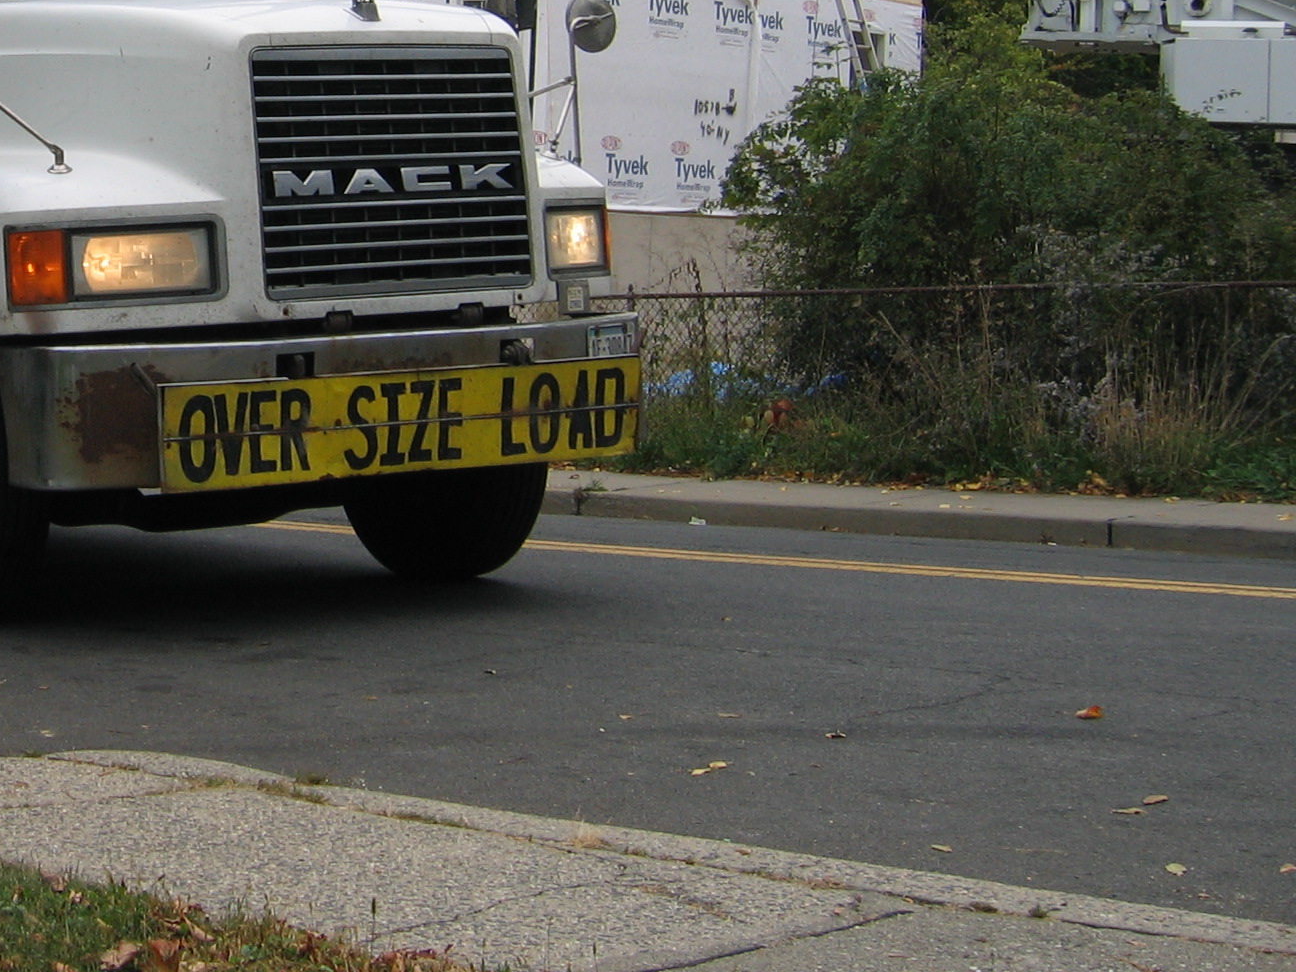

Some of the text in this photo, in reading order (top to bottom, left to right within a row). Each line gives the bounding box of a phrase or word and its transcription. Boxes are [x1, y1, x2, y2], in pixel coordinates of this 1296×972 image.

[714, 1, 753, 26] Tyvek
[806, 16, 842, 39] Tyvek
[606, 153, 648, 178] Tyvek
[675, 157, 715, 182] Tyvek
[271, 163, 514, 198] MACK
[179, 367, 625, 483] OVER SIZE LOAD
